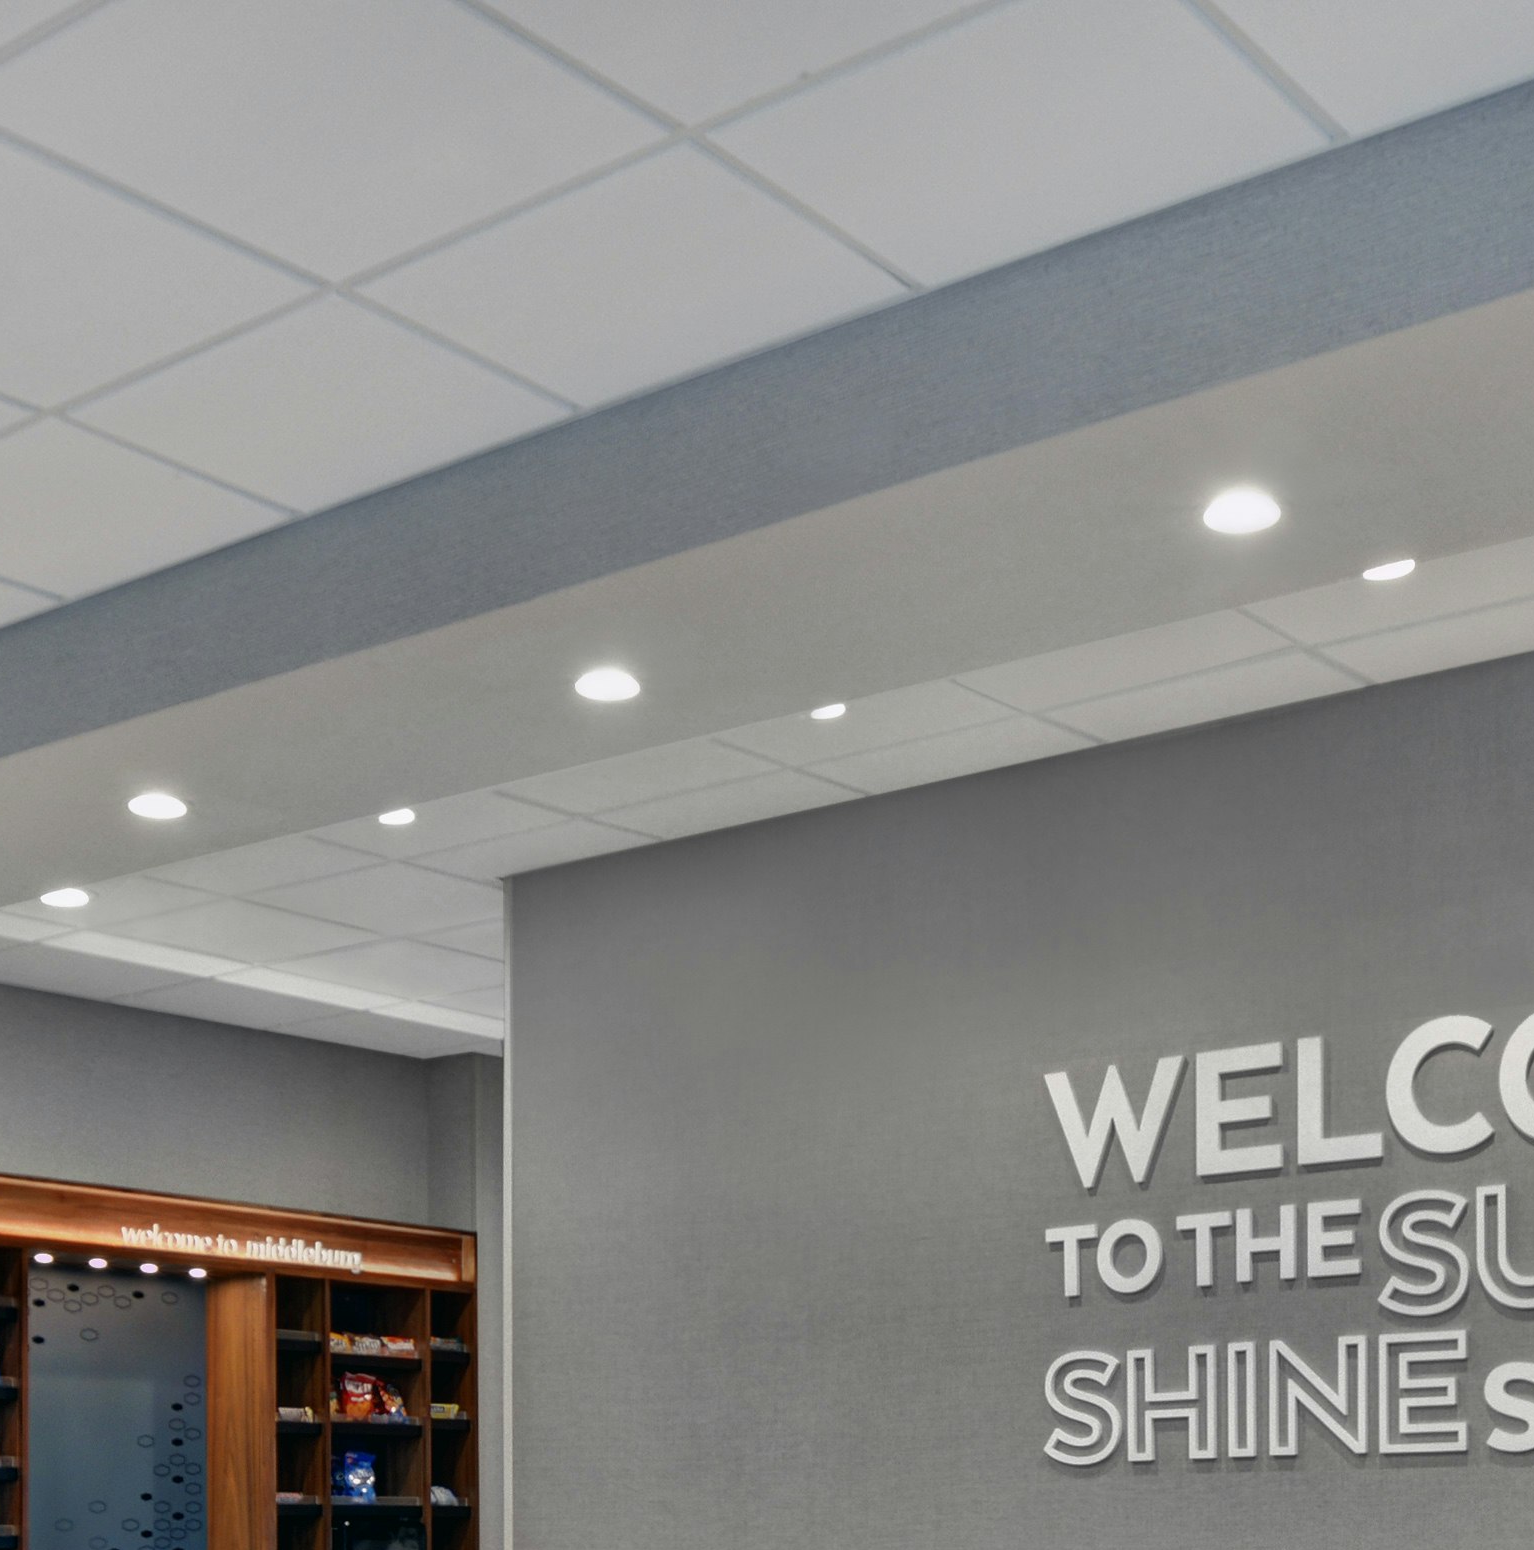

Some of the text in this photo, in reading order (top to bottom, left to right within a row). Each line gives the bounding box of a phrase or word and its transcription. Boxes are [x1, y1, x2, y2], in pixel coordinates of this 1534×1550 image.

[120, 1223, 363, 1274] welcome to middleburg
[1044, 1218, 1165, 1298] TO
[1176, 1198, 1363, 1287] THE
[1043, 1327, 1468, 1466] SHINE
